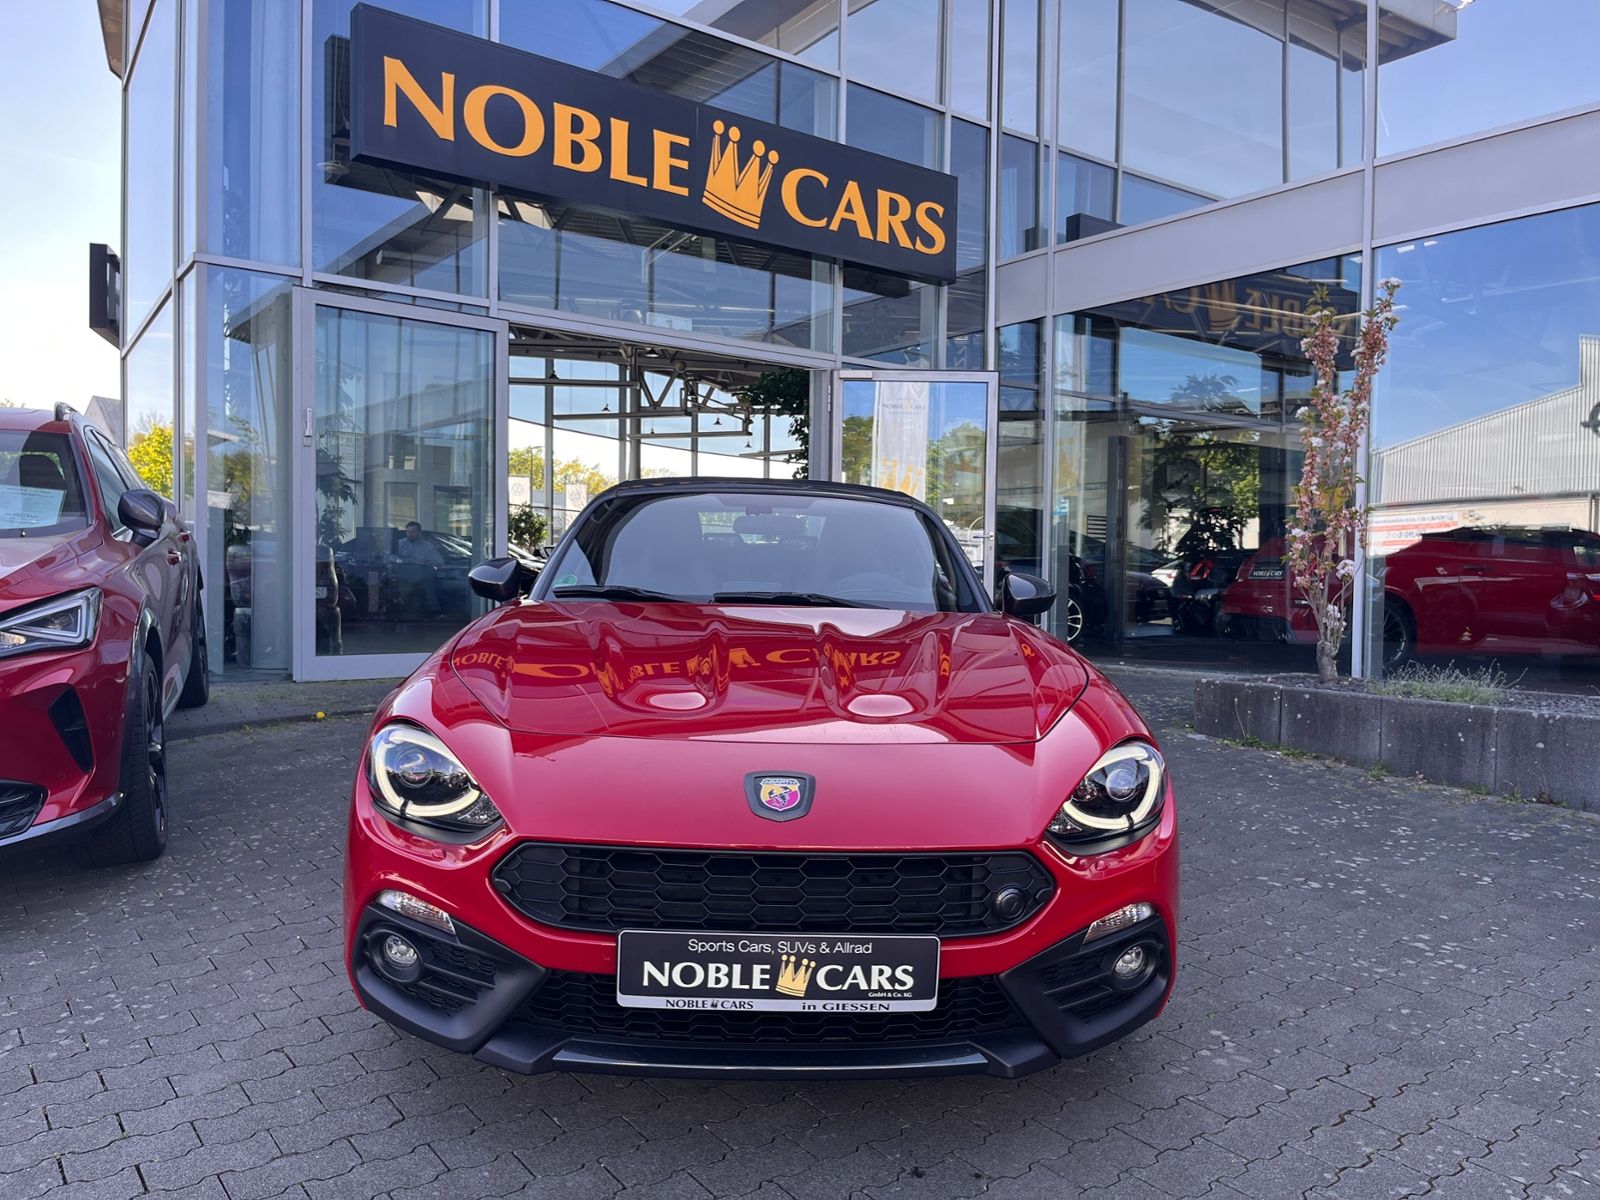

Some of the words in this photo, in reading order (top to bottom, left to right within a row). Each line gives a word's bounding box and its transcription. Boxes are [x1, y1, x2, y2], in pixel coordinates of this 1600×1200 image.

[383, 56, 690, 196] NOBLE
[781, 168, 946, 255] CARS
[688, 939, 735, 953] Sports
[738, 940, 775, 955] Cars,
[777, 941, 816, 954] SUVs
[819, 942, 830, 954] &
[833, 942, 873, 954] Allrad
[643, 961, 771, 989] NOBLE
[816, 965, 914, 991] CARS
[666, 999, 708, 1008] NOBLE
[721, 1000, 754, 1009] CARS
[802, 1002, 816, 1011] in
[822, 1002, 890, 1011] GIESSEN
